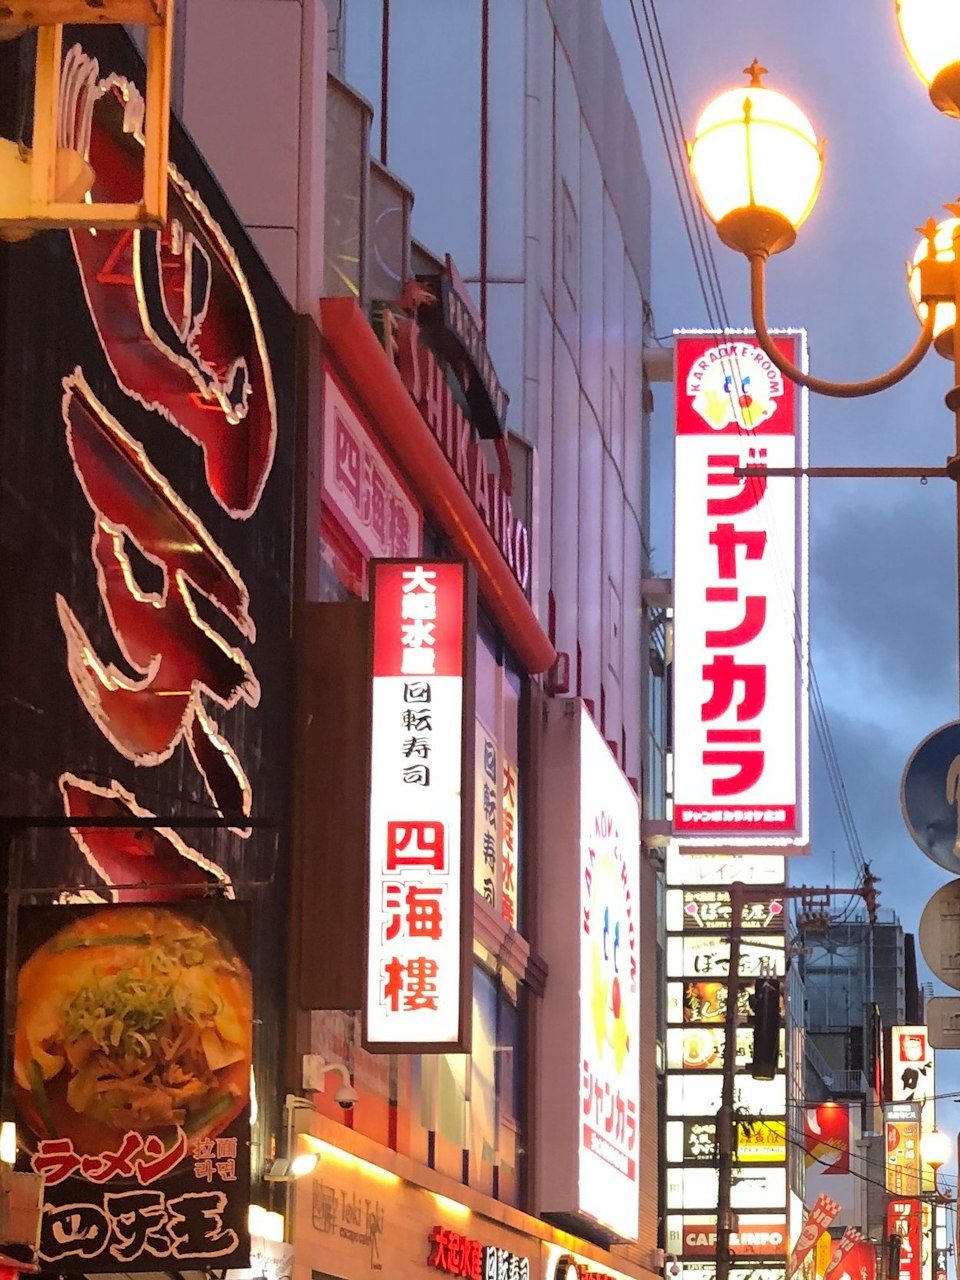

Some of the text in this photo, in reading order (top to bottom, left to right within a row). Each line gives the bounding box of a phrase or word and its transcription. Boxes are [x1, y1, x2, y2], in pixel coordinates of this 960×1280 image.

[701, 448, 768, 797] ジャンカラ
[401, 681, 434, 788] 回転寿司
[384, 819, 446, 1013] 四海樓
[31, 1124, 187, 1186] ラーメン
[686, 1231, 717, 1246] CAF
